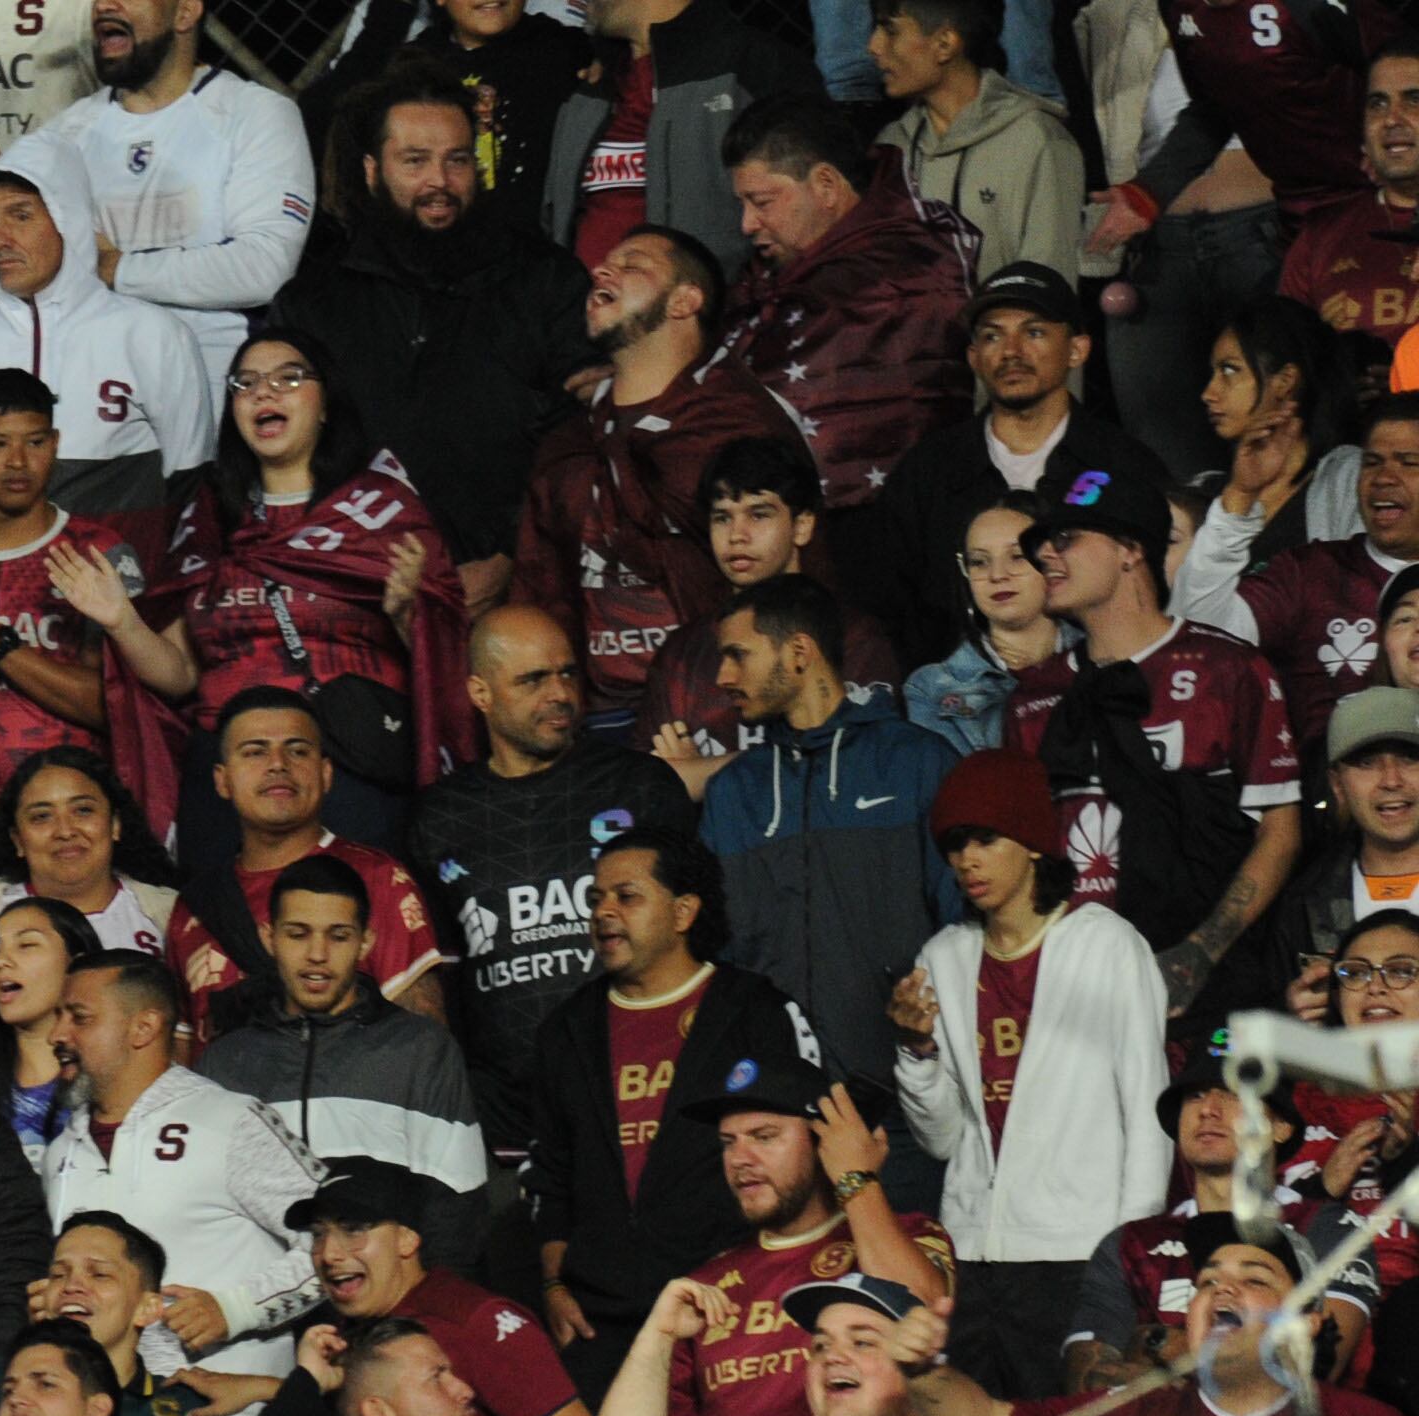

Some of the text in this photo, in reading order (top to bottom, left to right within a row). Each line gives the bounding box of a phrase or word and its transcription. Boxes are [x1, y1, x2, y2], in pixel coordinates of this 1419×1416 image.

[1250, 4, 1282, 47] S
[99, 380, 133, 422] S
[1065, 470, 1111, 505] S
[1170, 670, 1197, 701] S
[507, 875, 594, 930] BAC
[476, 947, 595, 992] LIBERTY
[154, 1123, 189, 1162] S
